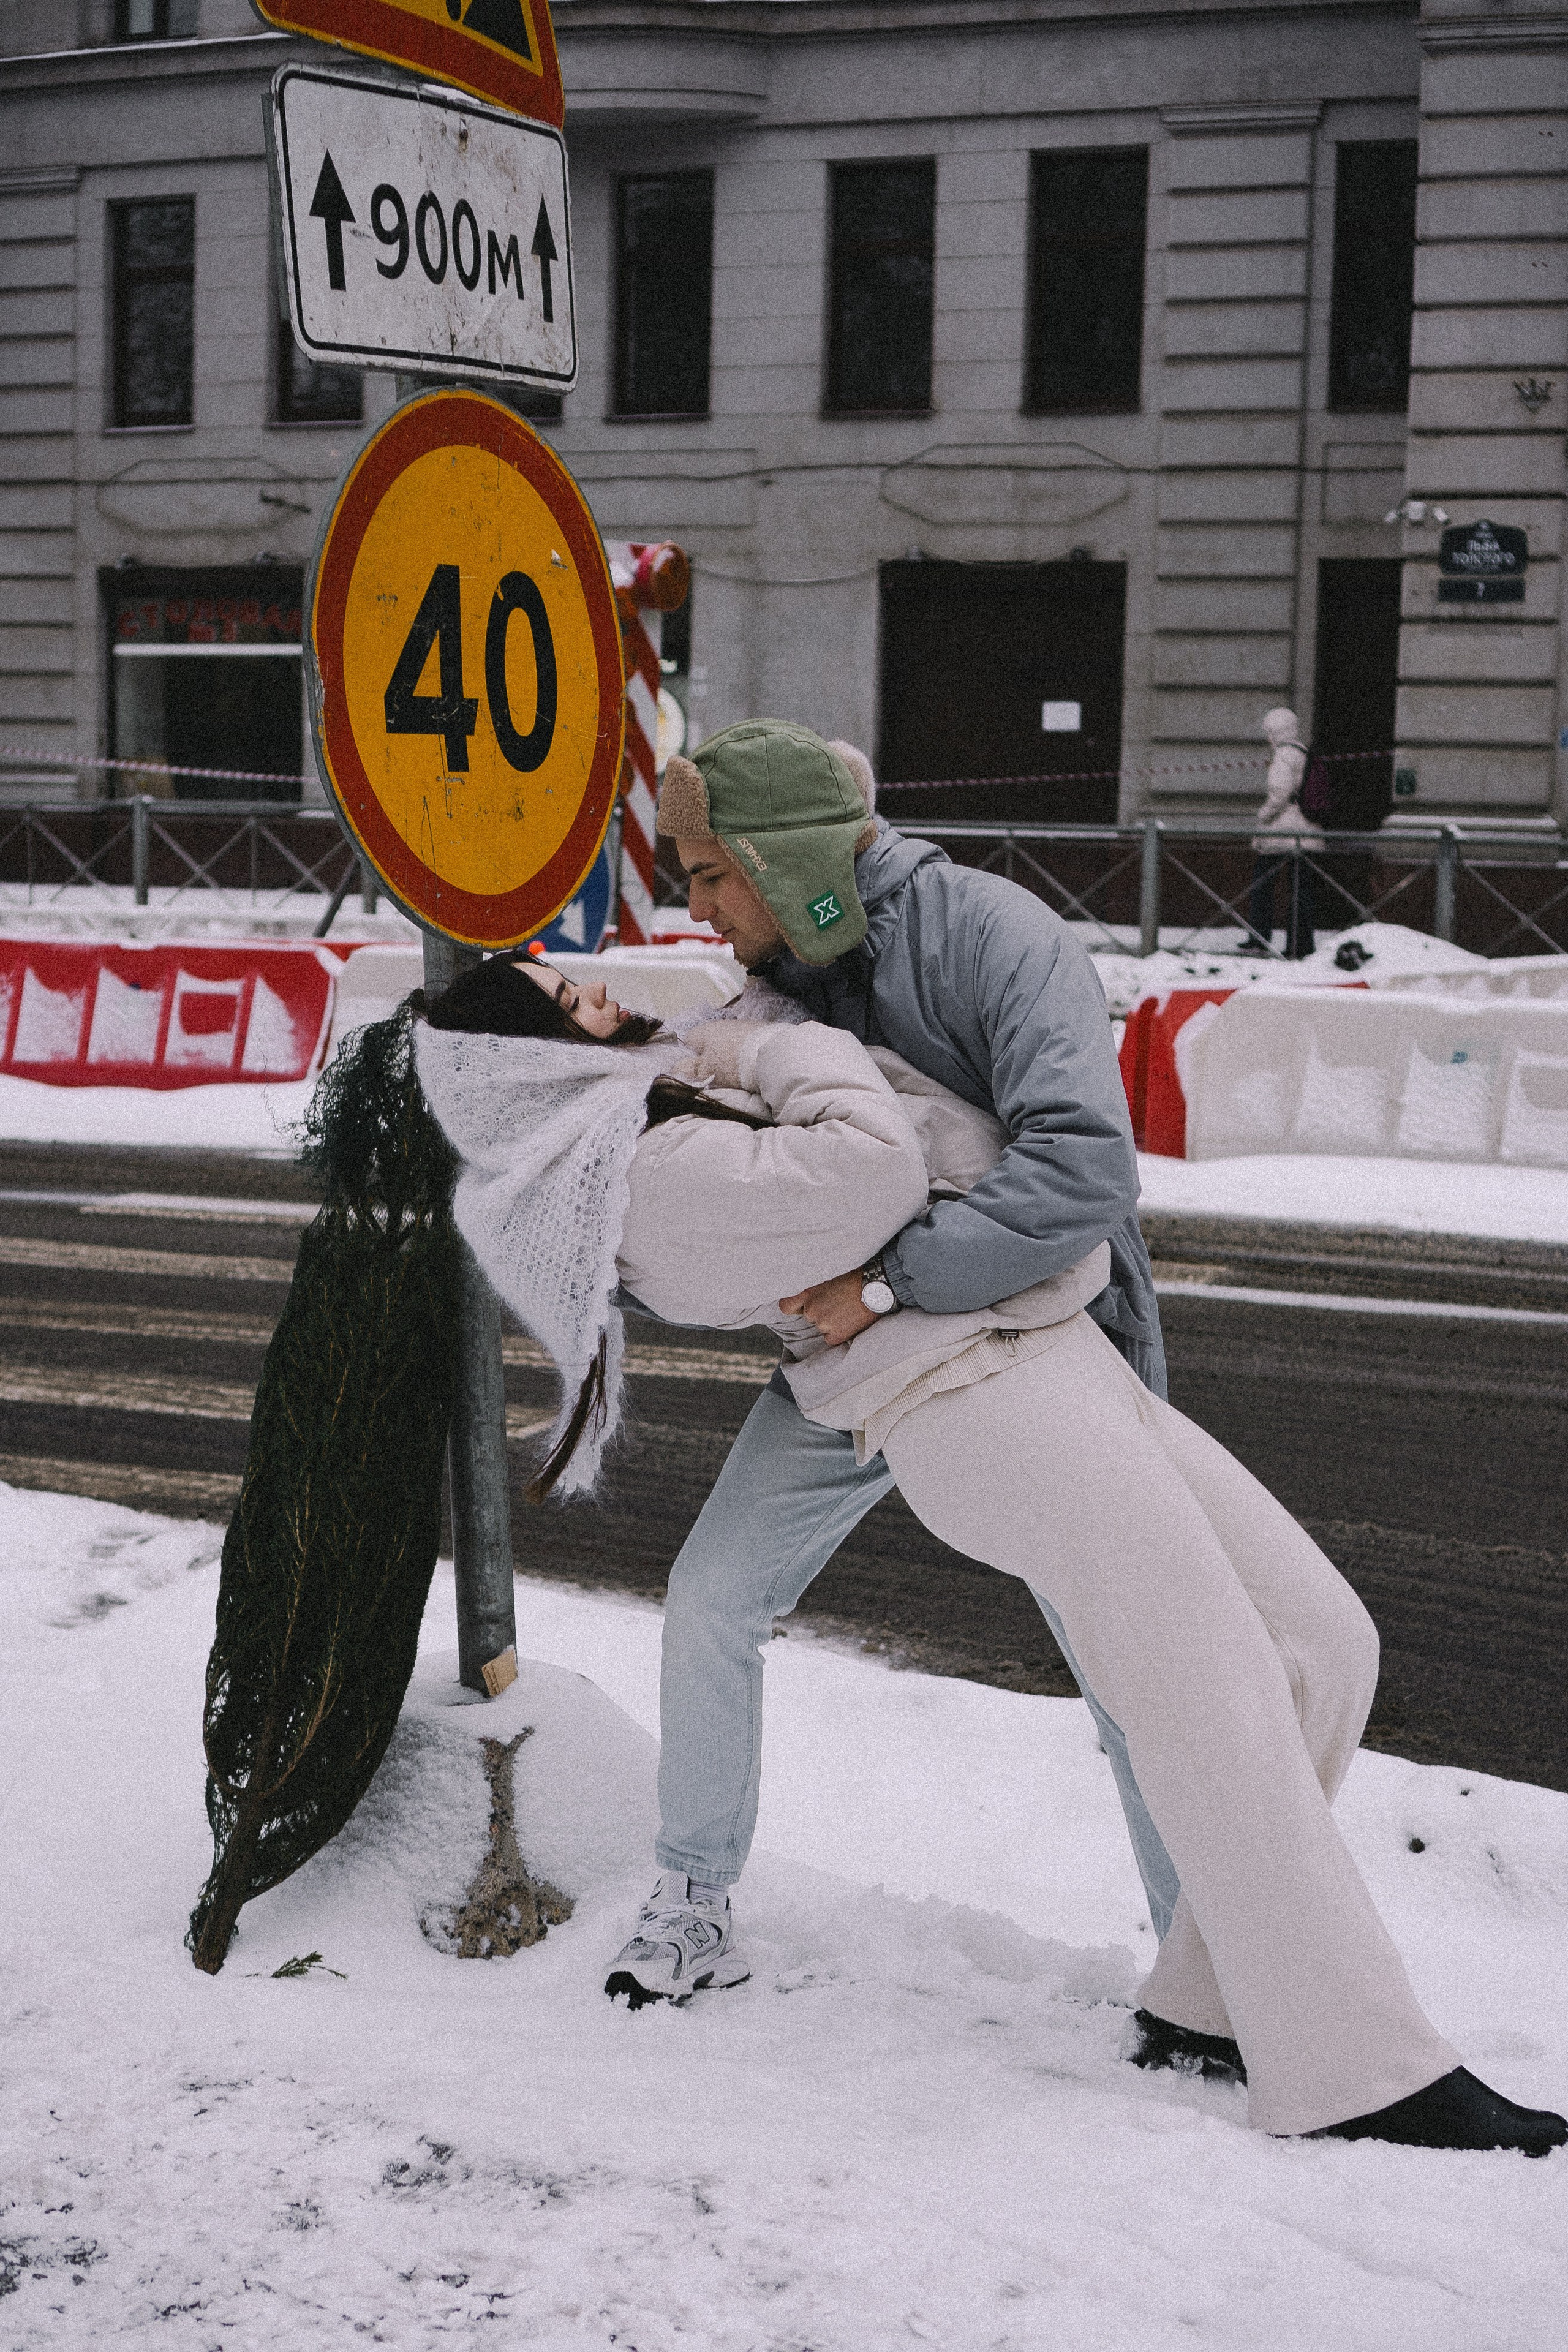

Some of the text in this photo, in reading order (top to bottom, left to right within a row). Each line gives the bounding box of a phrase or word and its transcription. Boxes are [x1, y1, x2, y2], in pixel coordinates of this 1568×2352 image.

[383, 563, 558, 774] 40
[736, 837, 767, 872] EXHAUST
[684, 1921, 710, 1949] N
